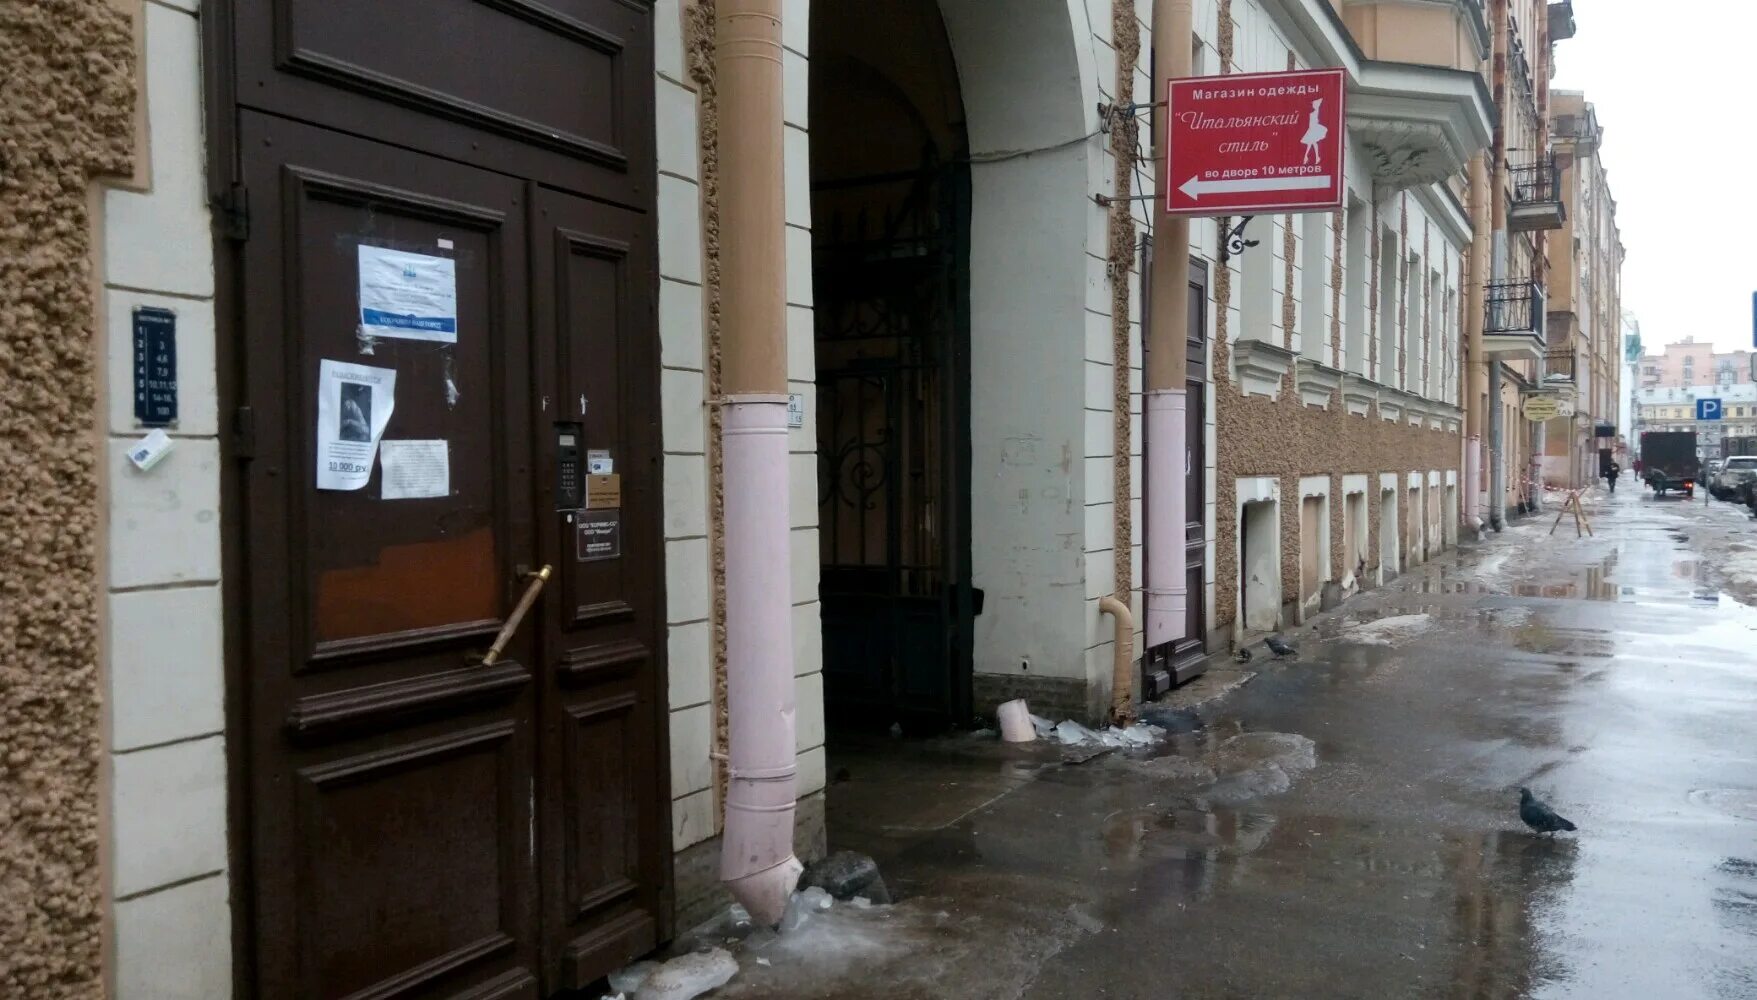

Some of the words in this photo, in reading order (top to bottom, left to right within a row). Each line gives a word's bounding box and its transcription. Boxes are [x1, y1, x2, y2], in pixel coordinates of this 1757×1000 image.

[1192, 88, 1255, 100] Магазин
[1258, 84, 1320, 97] одежды
[1175, 110, 1300, 130] "Итальянский
[1205, 170, 1219, 178] во
[1221, 167, 1258, 178] дворе
[1261, 166, 1275, 175] 10
[1278, 163, 1322, 176] метров
[1703, 400, 1717, 418] P
[328, 461, 338, 470] 10
[339, 462, 354, 471] 000
